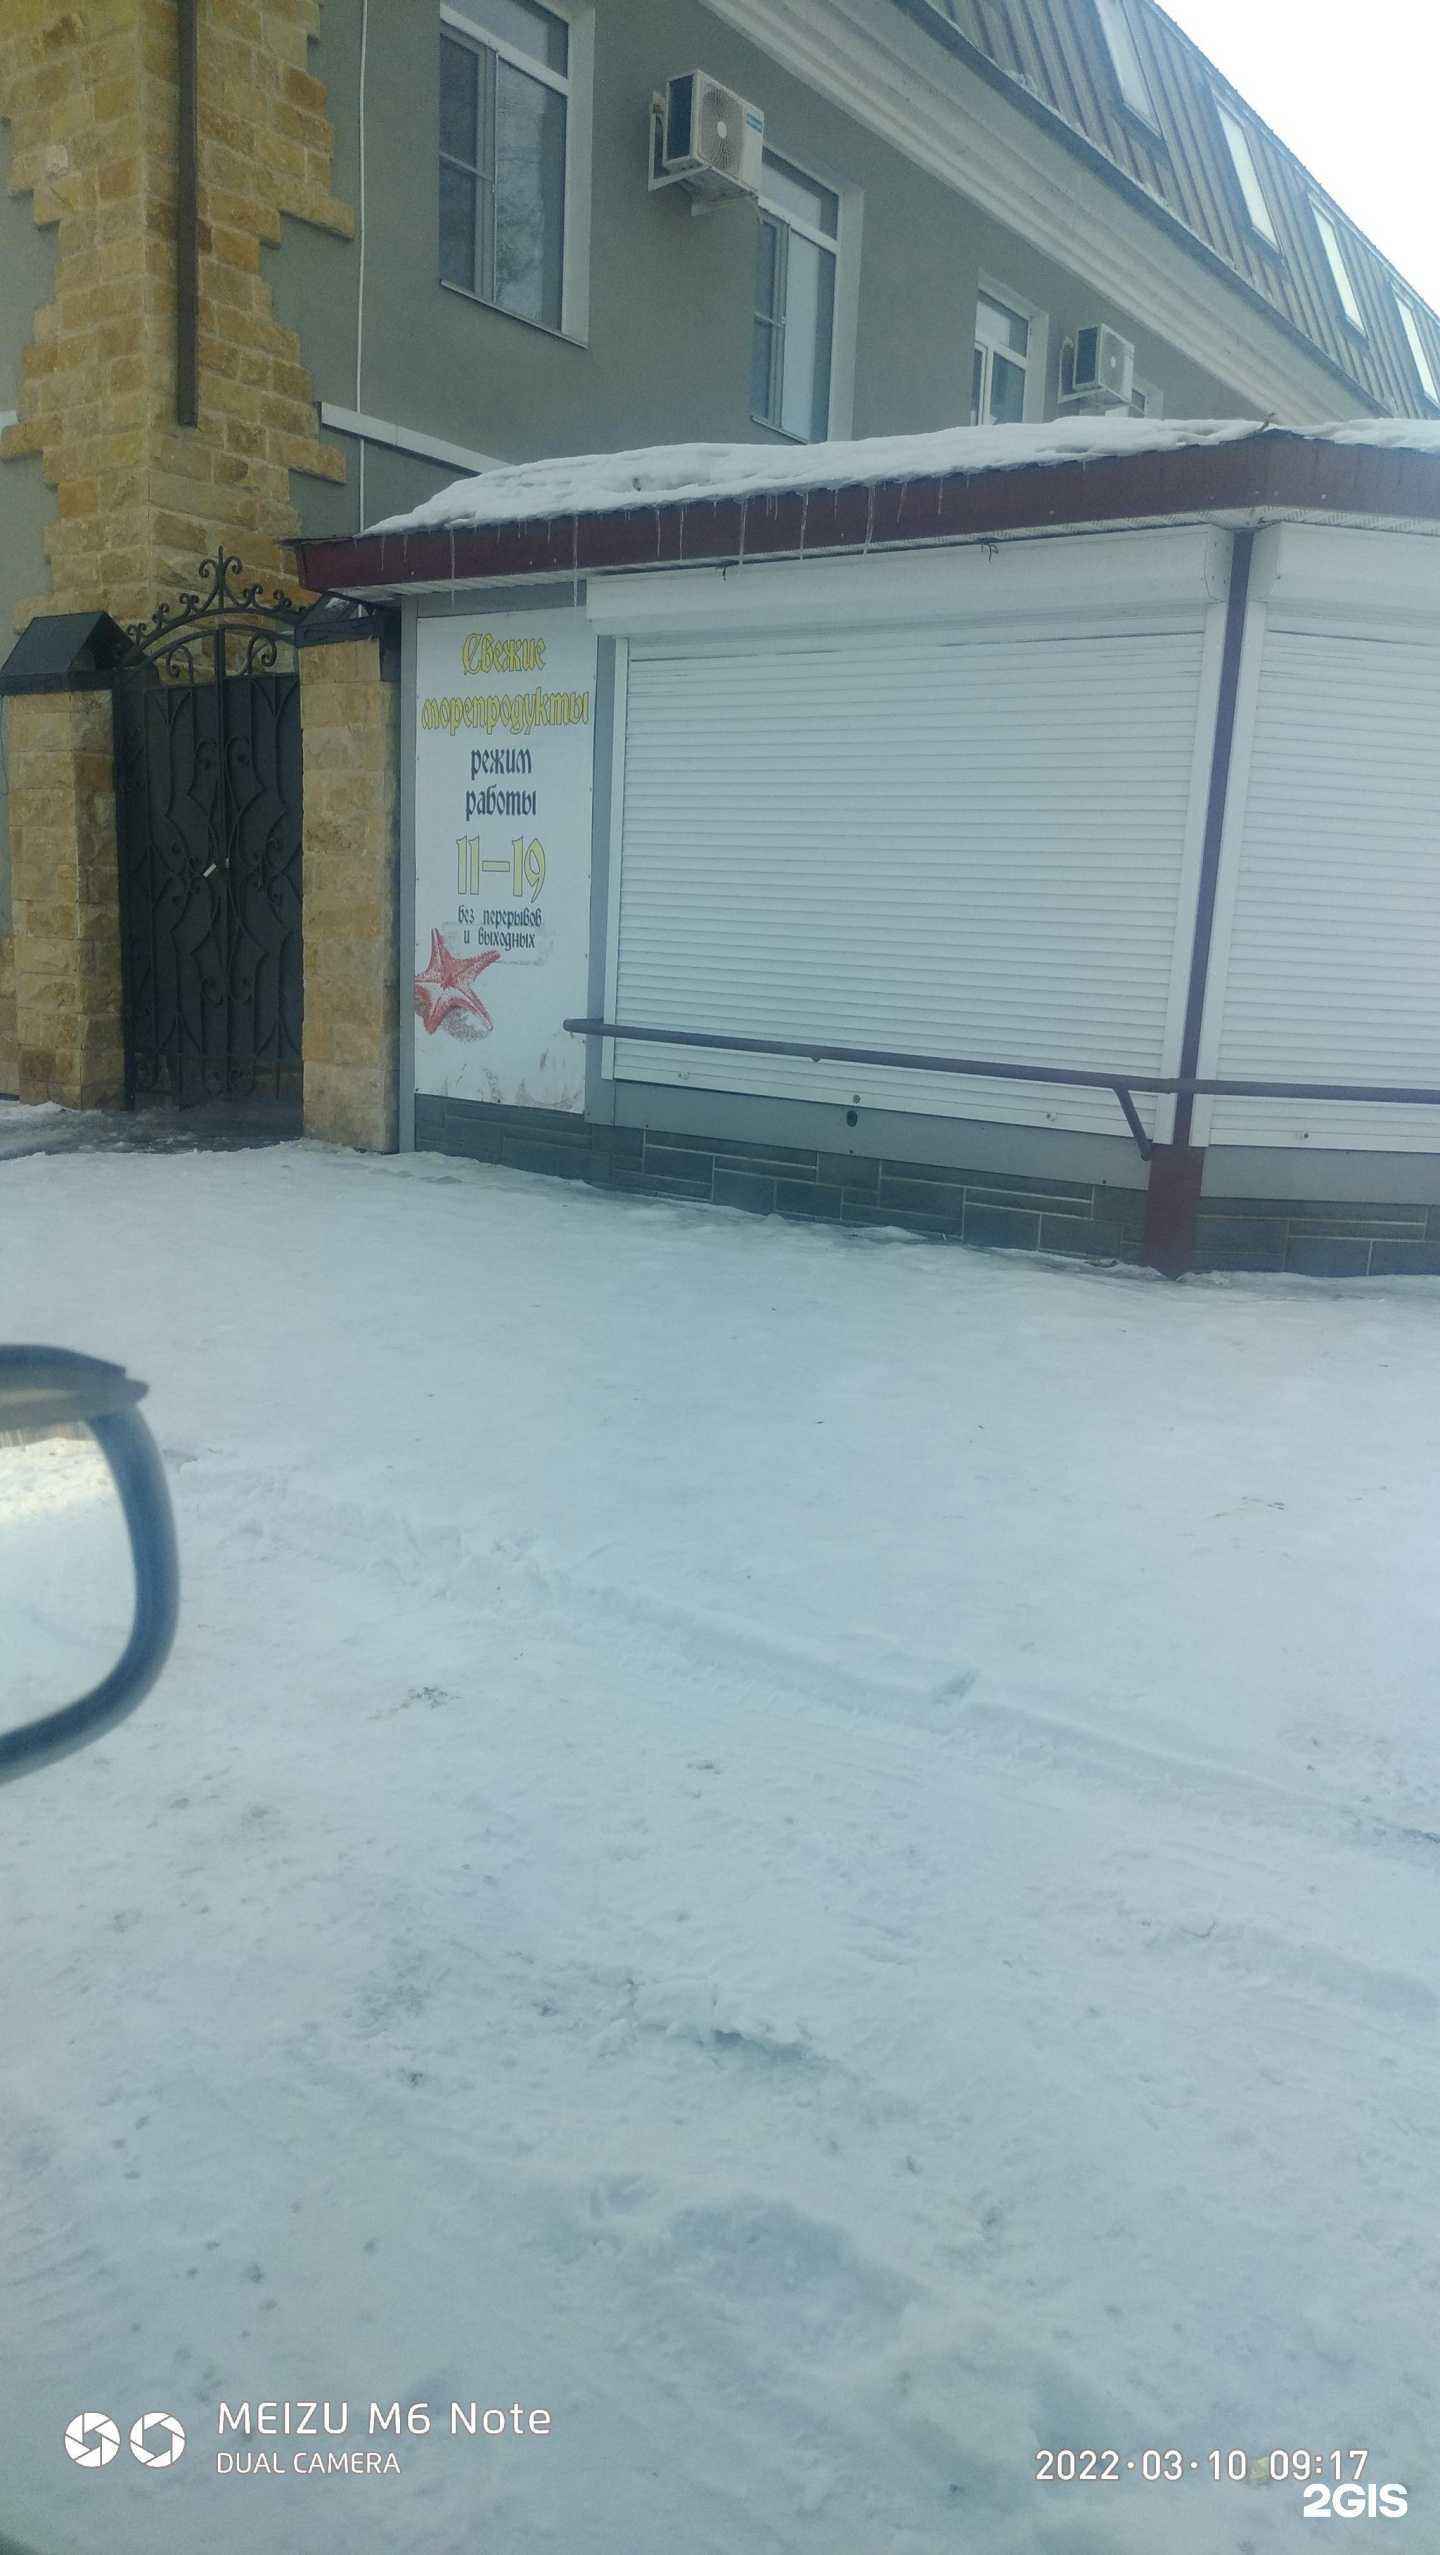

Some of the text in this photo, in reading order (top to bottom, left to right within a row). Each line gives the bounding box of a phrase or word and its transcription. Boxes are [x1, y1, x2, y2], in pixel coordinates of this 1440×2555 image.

[462, 632, 547, 675] Свежие
[421, 686, 590, 736] морепродукты
[471, 749, 532, 780] режим
[465, 784, 537, 821] работы
[458, 905, 542, 929] без перерывов
[463, 928, 536, 951] и выходных
